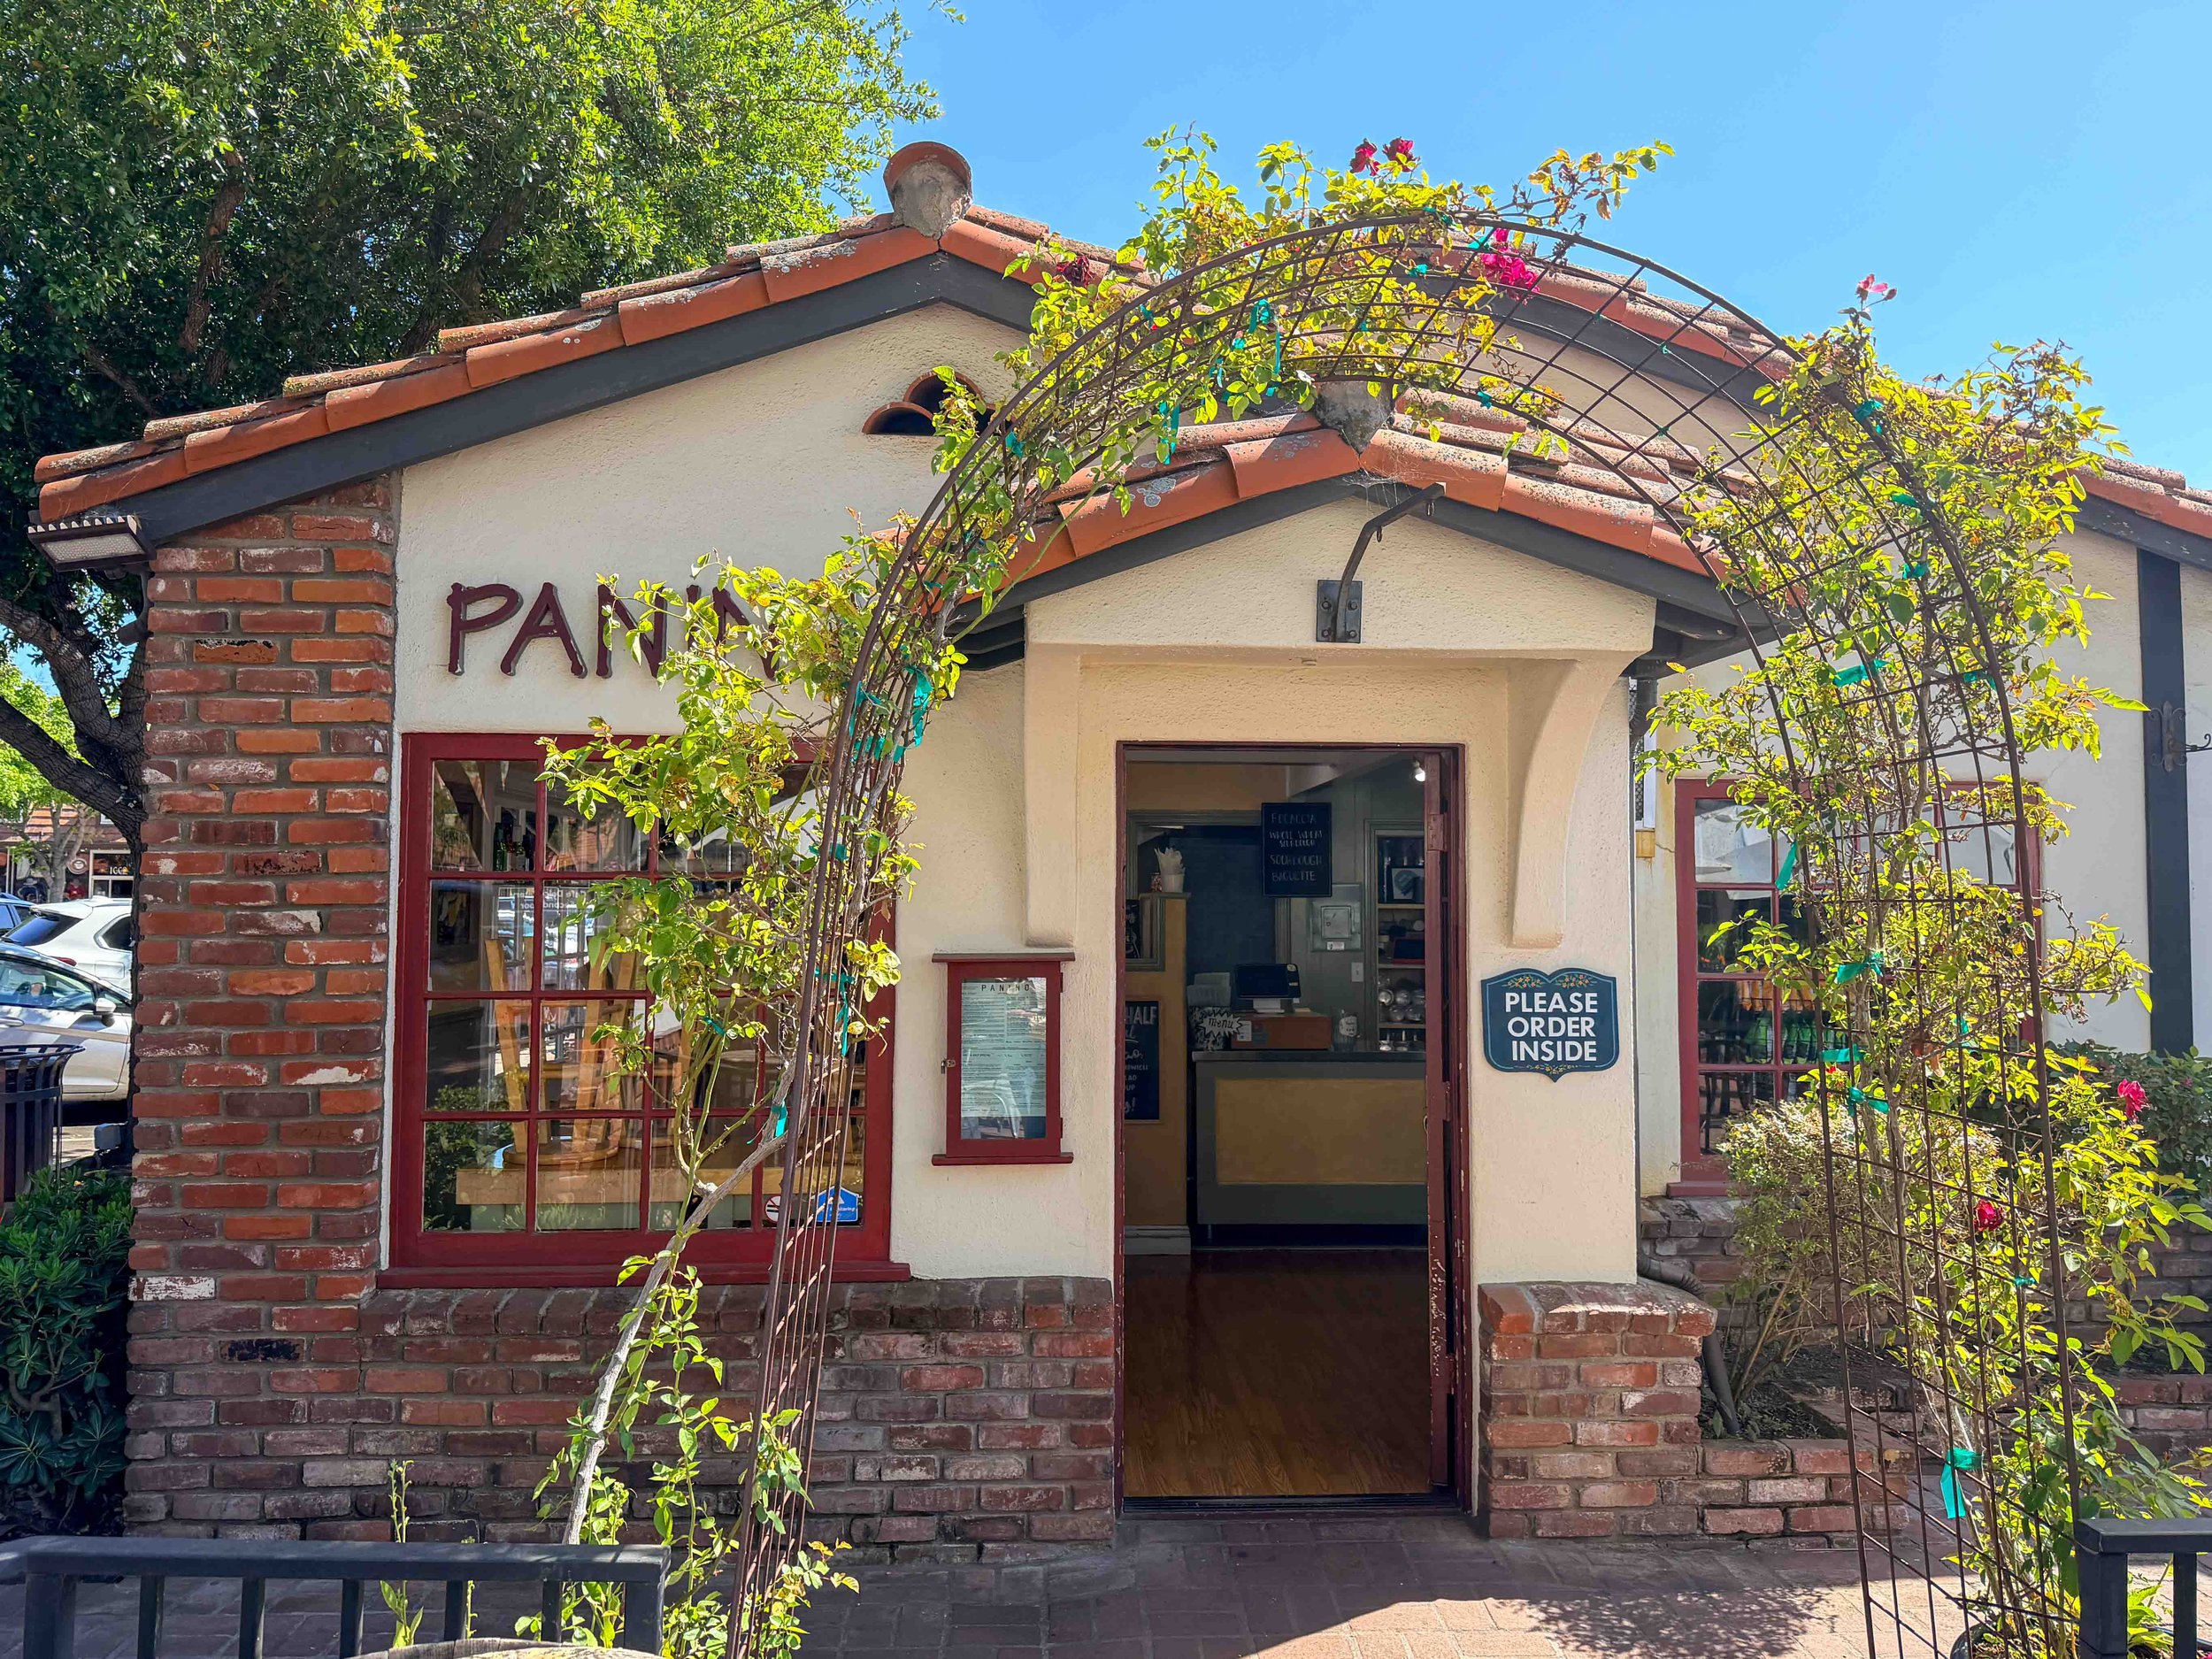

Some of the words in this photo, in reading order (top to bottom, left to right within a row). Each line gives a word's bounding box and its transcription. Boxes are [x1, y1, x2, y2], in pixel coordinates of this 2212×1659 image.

[1505, 992, 1598, 1013] PLEASE
[1125, 1006, 1157, 1025] HALF
[1507, 1017, 1596, 1038] ORDER
[1512, 1041, 1597, 1062] INSIDE
